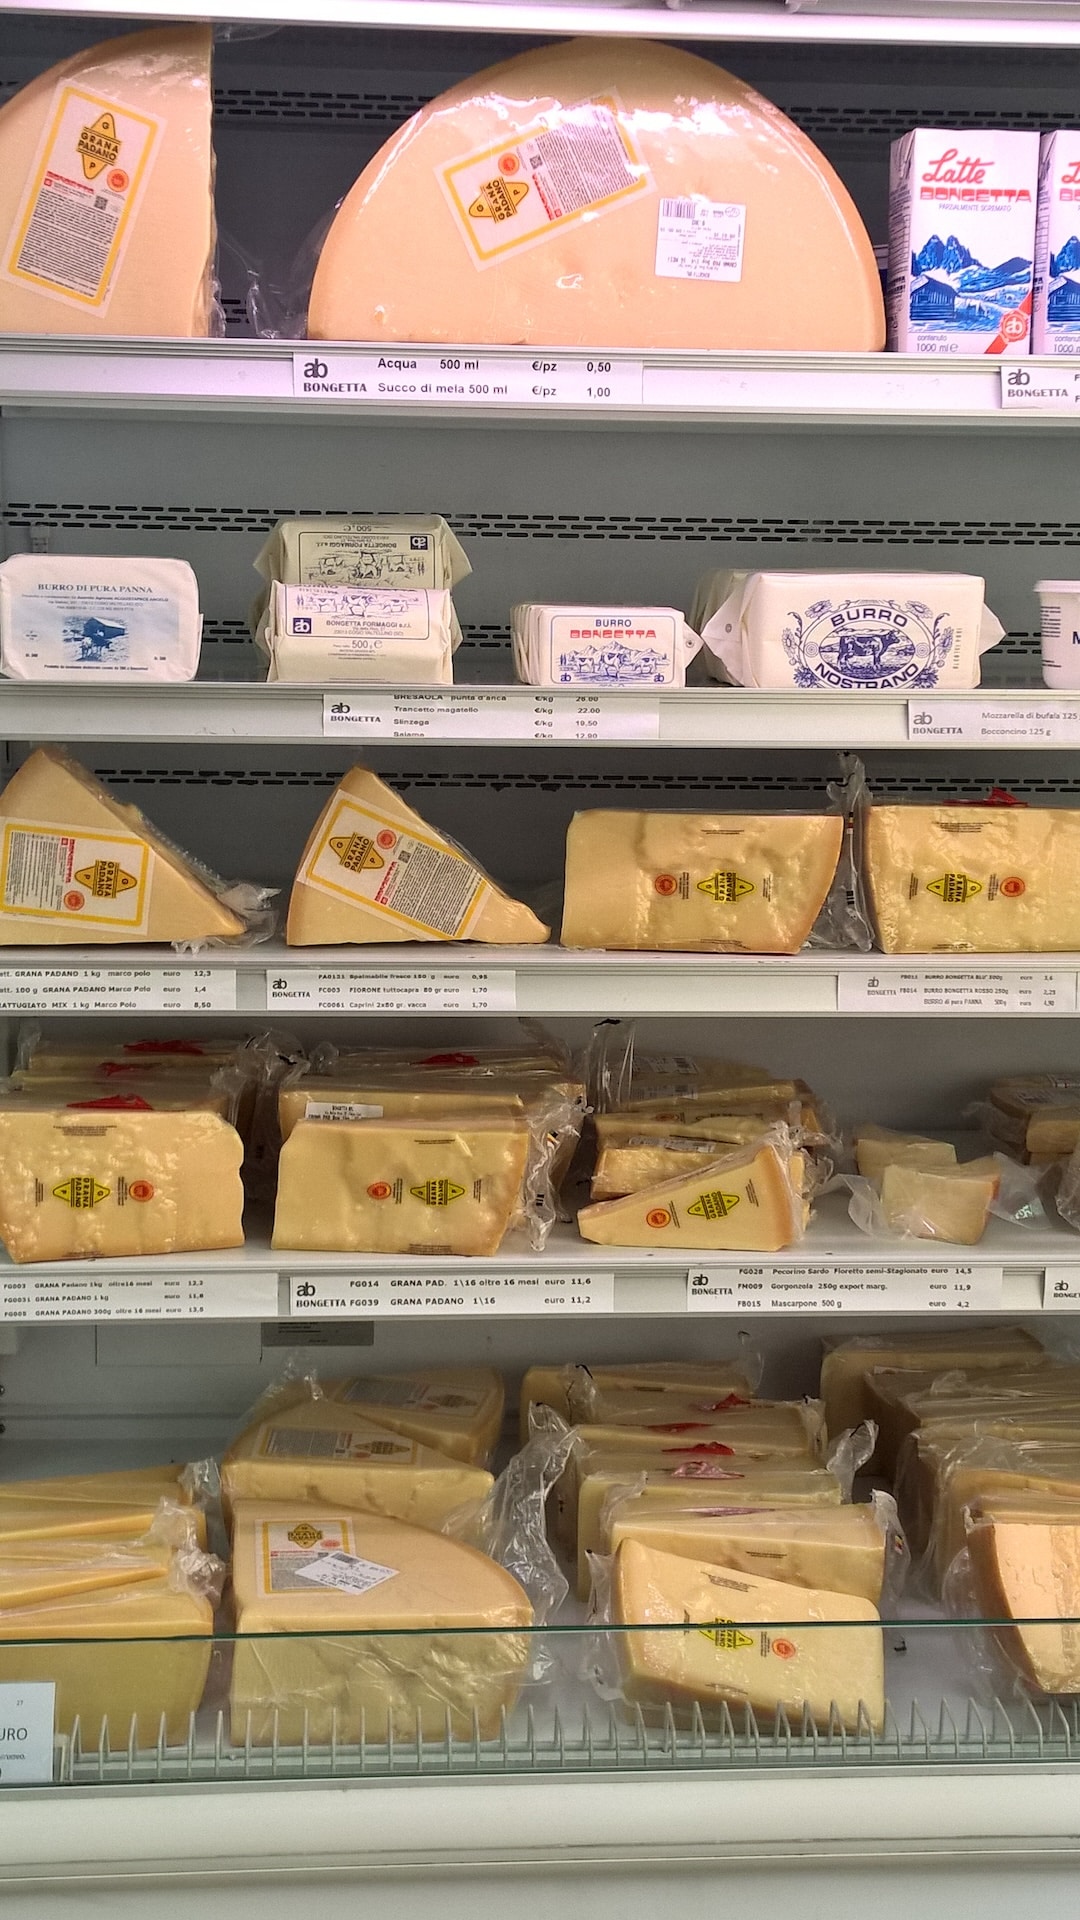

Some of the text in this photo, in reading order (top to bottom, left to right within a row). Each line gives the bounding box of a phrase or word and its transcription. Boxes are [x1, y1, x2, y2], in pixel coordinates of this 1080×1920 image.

[80, 131, 119, 155] GRANA
[77, 139, 117, 161] PADANO
[922, 149, 995, 184] Latte
[492, 179, 513, 217] PADANO
[920, 187, 1032, 202] BONGETTA
[487, 182, 505, 221] GRANA
[1005, 315, 1023, 332] ab
[916, 343, 949, 352] 1000 ml
[304, 358, 328, 378] ab
[377, 358, 611, 374] Acqua 500 ml €/pz 0,50
[1007, 368, 1030, 386] ab
[303, 383, 367, 393] BONGETTA
[378, 383, 611, 399] Succo di mela 500 ml €/pz 1,00
[1007, 388, 1069, 397] BONGETTA
[38, 583, 74, 591] BURRO
[76, 584, 88, 592] DI
[89, 585, 117, 593] PURA
[595, 619, 632, 627] BURRO
[831, 608, 908, 628] BURRO
[570, 629, 656, 639] BONGETTA
[352, 640, 369, 649] 500
[560, 672, 572, 682] ab
[653, 673, 665, 682] ab
[814, 663, 920, 689] NOSTRANO
[331, 703, 351, 714] ab
[330, 715, 381, 723] BONGETTA
[913, 712, 933, 725] ab
[1062, 712, 1078, 720] 125
[912, 727, 963, 735] BONGETTA
[344, 835, 364, 869] GRANA
[350, 838, 370, 872] PADANO
[97, 860, 107, 896] PADANO
[104, 862, 115, 897] GRANA
[134, 970, 151, 978] polo
[272, 978, 287, 989] ab
[867, 976, 880, 987] ab
[193, 1001, 211, 1009] 8,50
[350, 1280, 379, 1288] FG014
[390, 1279, 422, 1287] GRANA
[425, 1279, 447, 1287] PAD.
[454, 1278, 476, 1286] 1\16
[479, 1278, 501, 1286] oltre
[503, 1278, 515, 1286] 16
[517, 1278, 539, 1286] mesi
[571, 1278, 591, 1286] 11,6
[692, 1275, 709, 1286] ab
[1054, 1280, 1069, 1291] ab
[296, 1282, 316, 1296] ab
[839, 1283, 864, 1291] export
[296, 1299, 346, 1308] BONGETTA
[390, 1298, 422, 1306] GRANA
[425, 1297, 464, 1305] PADANO
[473, 1297, 495, 1305] 1\16
[571, 1296, 591, 1304] 11,2
[771, 1300, 817, 1308] Mascarpone
